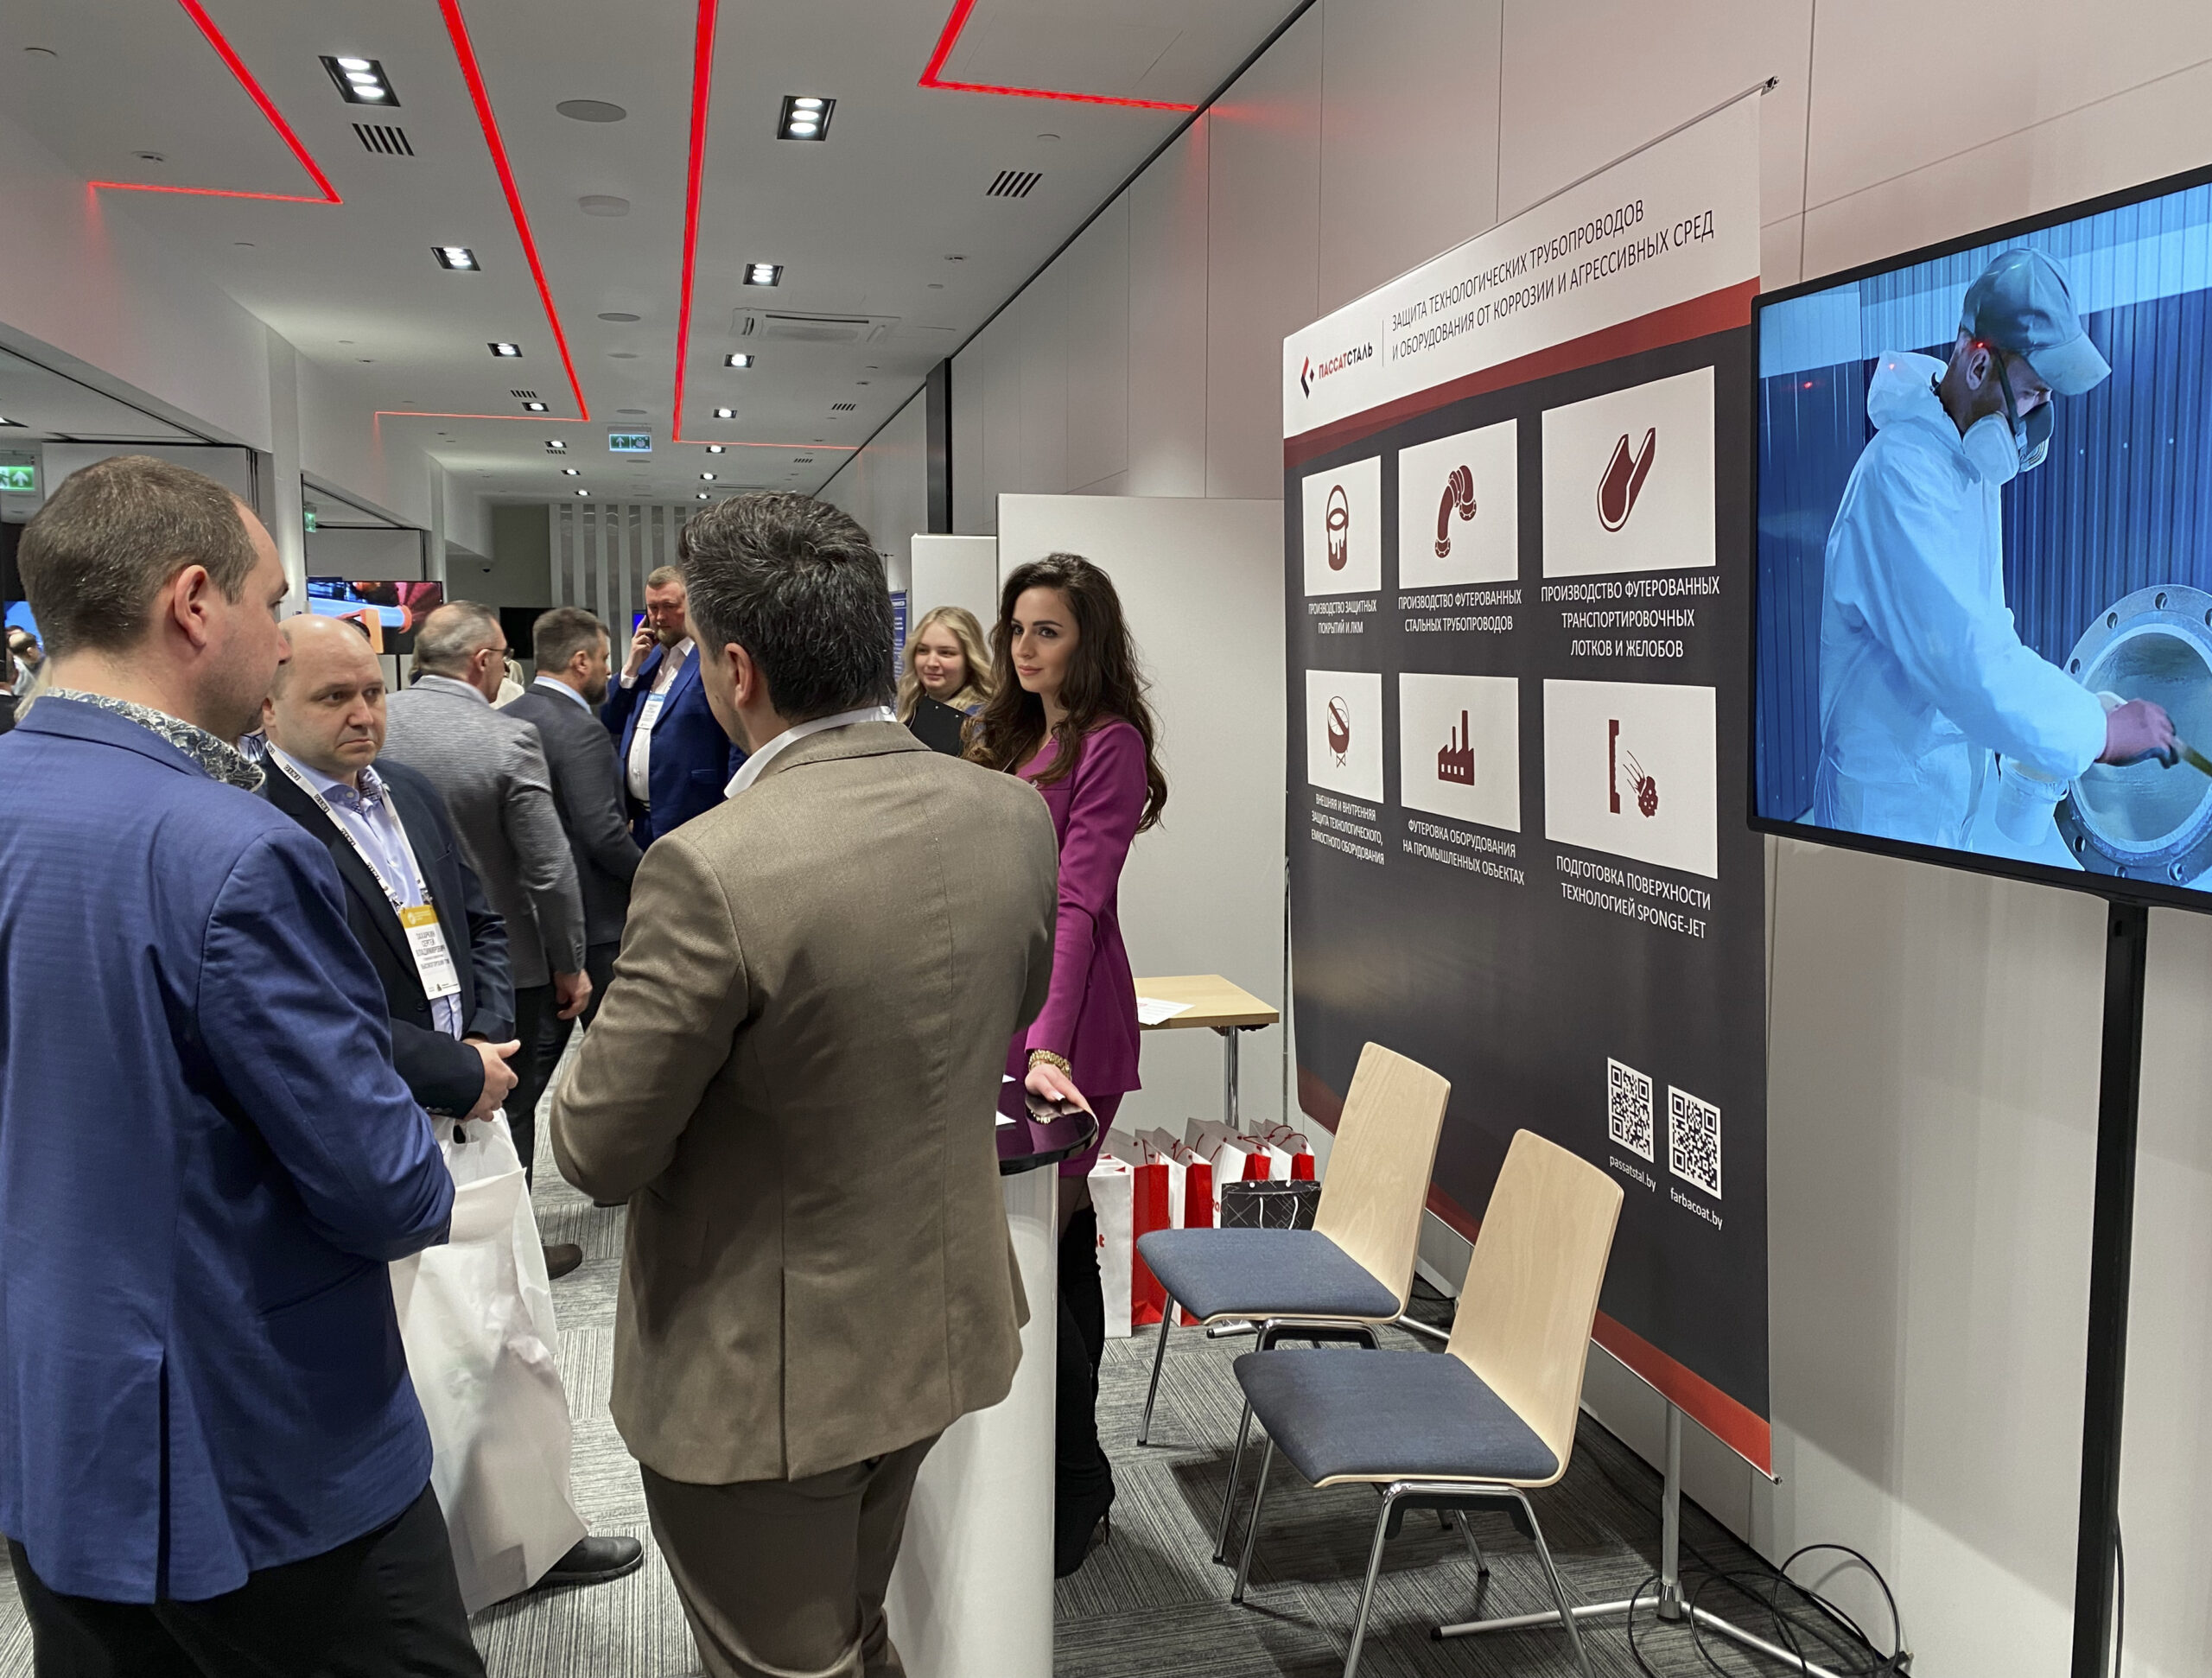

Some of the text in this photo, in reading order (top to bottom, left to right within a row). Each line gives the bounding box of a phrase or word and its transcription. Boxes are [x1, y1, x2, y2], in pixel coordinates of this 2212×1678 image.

[1393, 200, 1643, 331] ЗАЩИТА ТЕХНОЛОГИЧЕСКИХ ТРУБОПРОВОДОВ
[1393, 210, 1713, 361] И ОБОРУДОВАНИЯ ОТ КОРРОЗИИ И АГРЕССИВНЫХ СРЕД
[1319, 342, 1372, 378] ПАССАТСТАЛЬ
[1399, 589, 1522, 611] ПРОИЗВОДСТВО ФУТЕРОВАННЫХ
[1541, 576, 1719, 603] ПРОИЗВОДСТВО ФУТЕРОВАННЫХ
[1309, 600, 1376, 616] ПРОИЗВОДСТВО ЗАЩИТНЫХ
[1405, 616, 1513, 633] СТАЛЬНЫХ ТРУБОПРОВОДОВ
[1561, 609, 1694, 627] ТРАНСПОРТИРОВОЧНЫХ
[1571, 640, 1683, 657] ЛОТКОВ И ЖЕЛОБОВ
[1316, 794, 1376, 821] ВНЕШНЯЯ И ВНУТРЕННЯЯ
[1408, 819, 1516, 858] ФУТЕРОВКА ОБОРУДОВАНИЯ
[1403, 840, 1524, 885] НА ПРОМЫШЛЕННЫХ ОБЪЕКТАХ
[1557, 855, 1710, 910] ПОДГОТОВКА ПОВЕРХНОСТИ
[1561, 883, 1706, 938] ТЕХНОЛОГИЕЙ SPONGE-JET
[1610, 1156, 1656, 1192] passatstal.by
[1670, 1188, 1722, 1230] farbacoat.by
